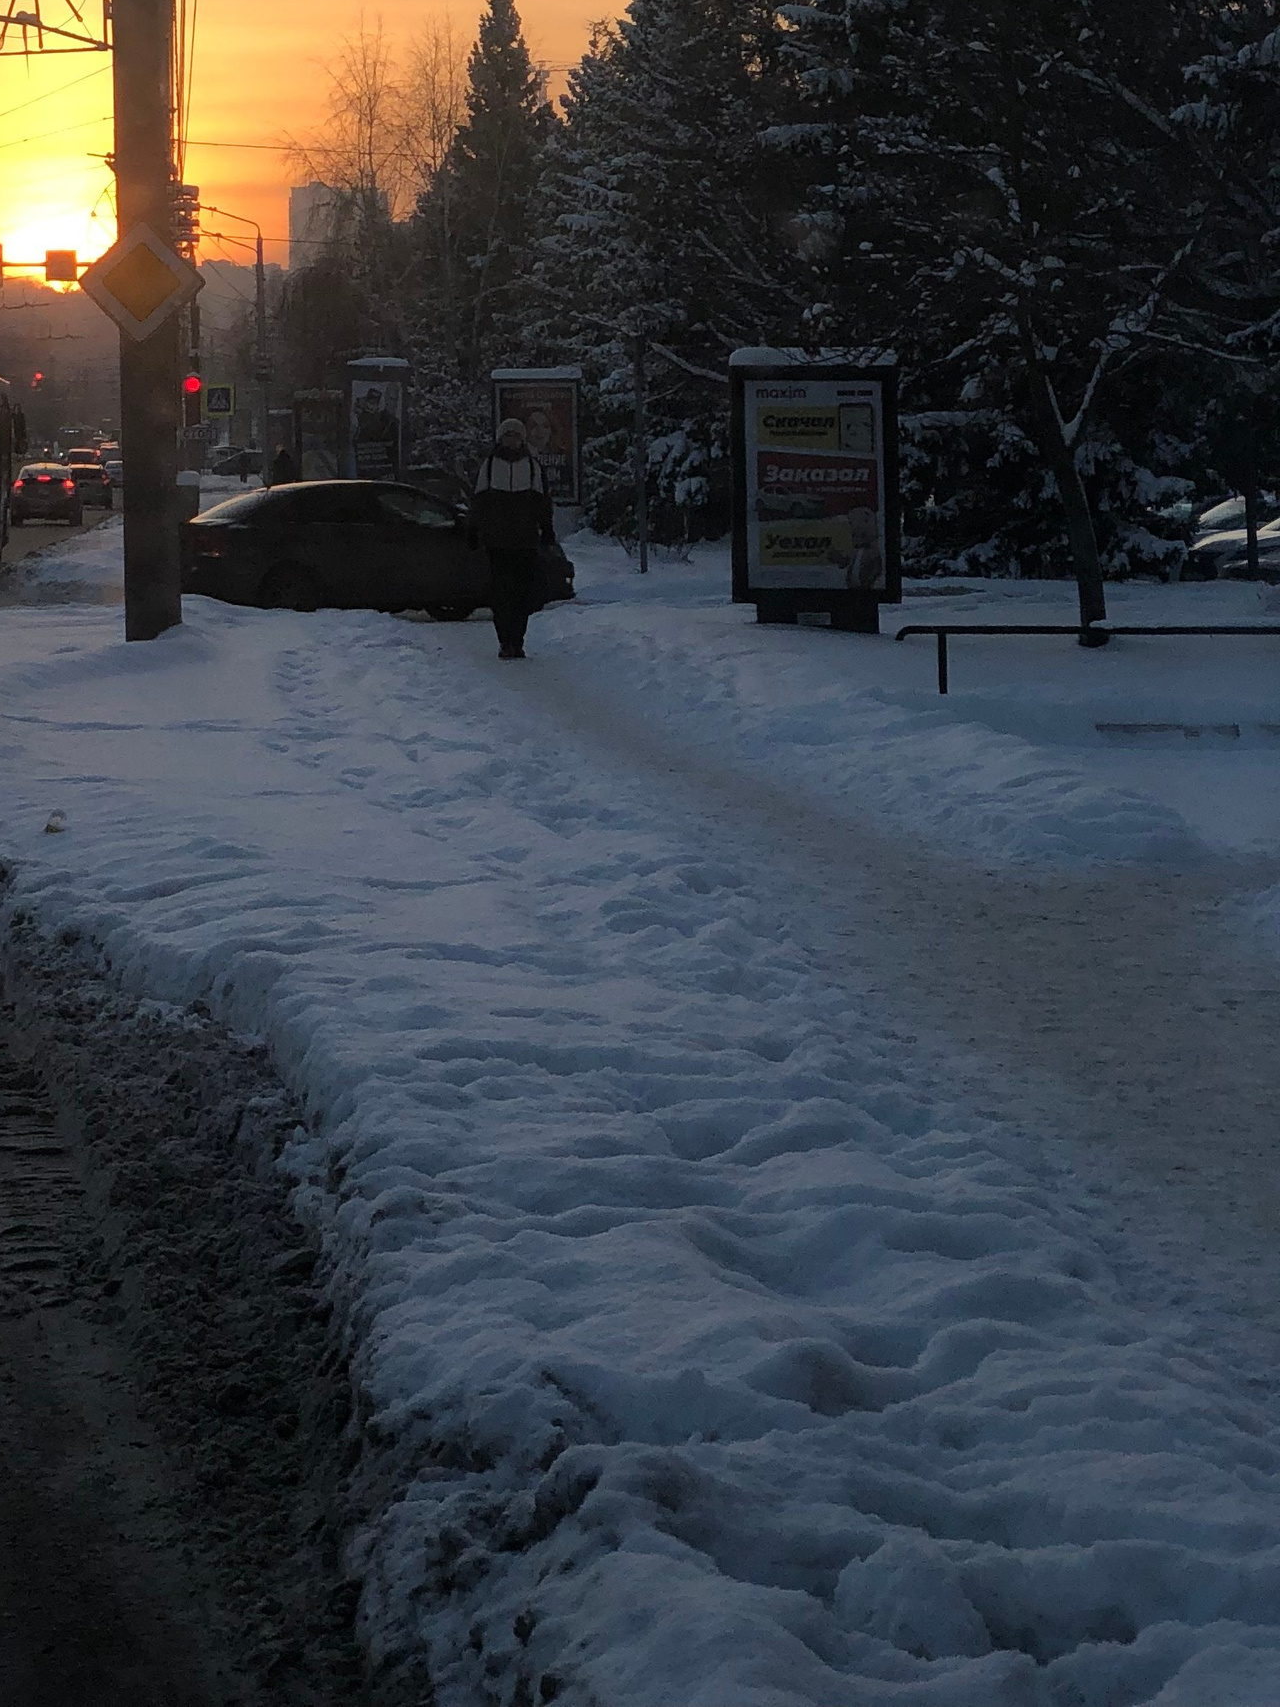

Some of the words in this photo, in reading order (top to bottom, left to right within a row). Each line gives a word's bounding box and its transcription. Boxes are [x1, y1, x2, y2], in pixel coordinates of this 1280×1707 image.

[756, 385, 807, 399] maxim
[762, 414, 835, 429] Скачал
[183, 429, 213, 439] СТОП
[763, 464, 871, 483] Заказал
[765, 532, 833, 550] Уехал
